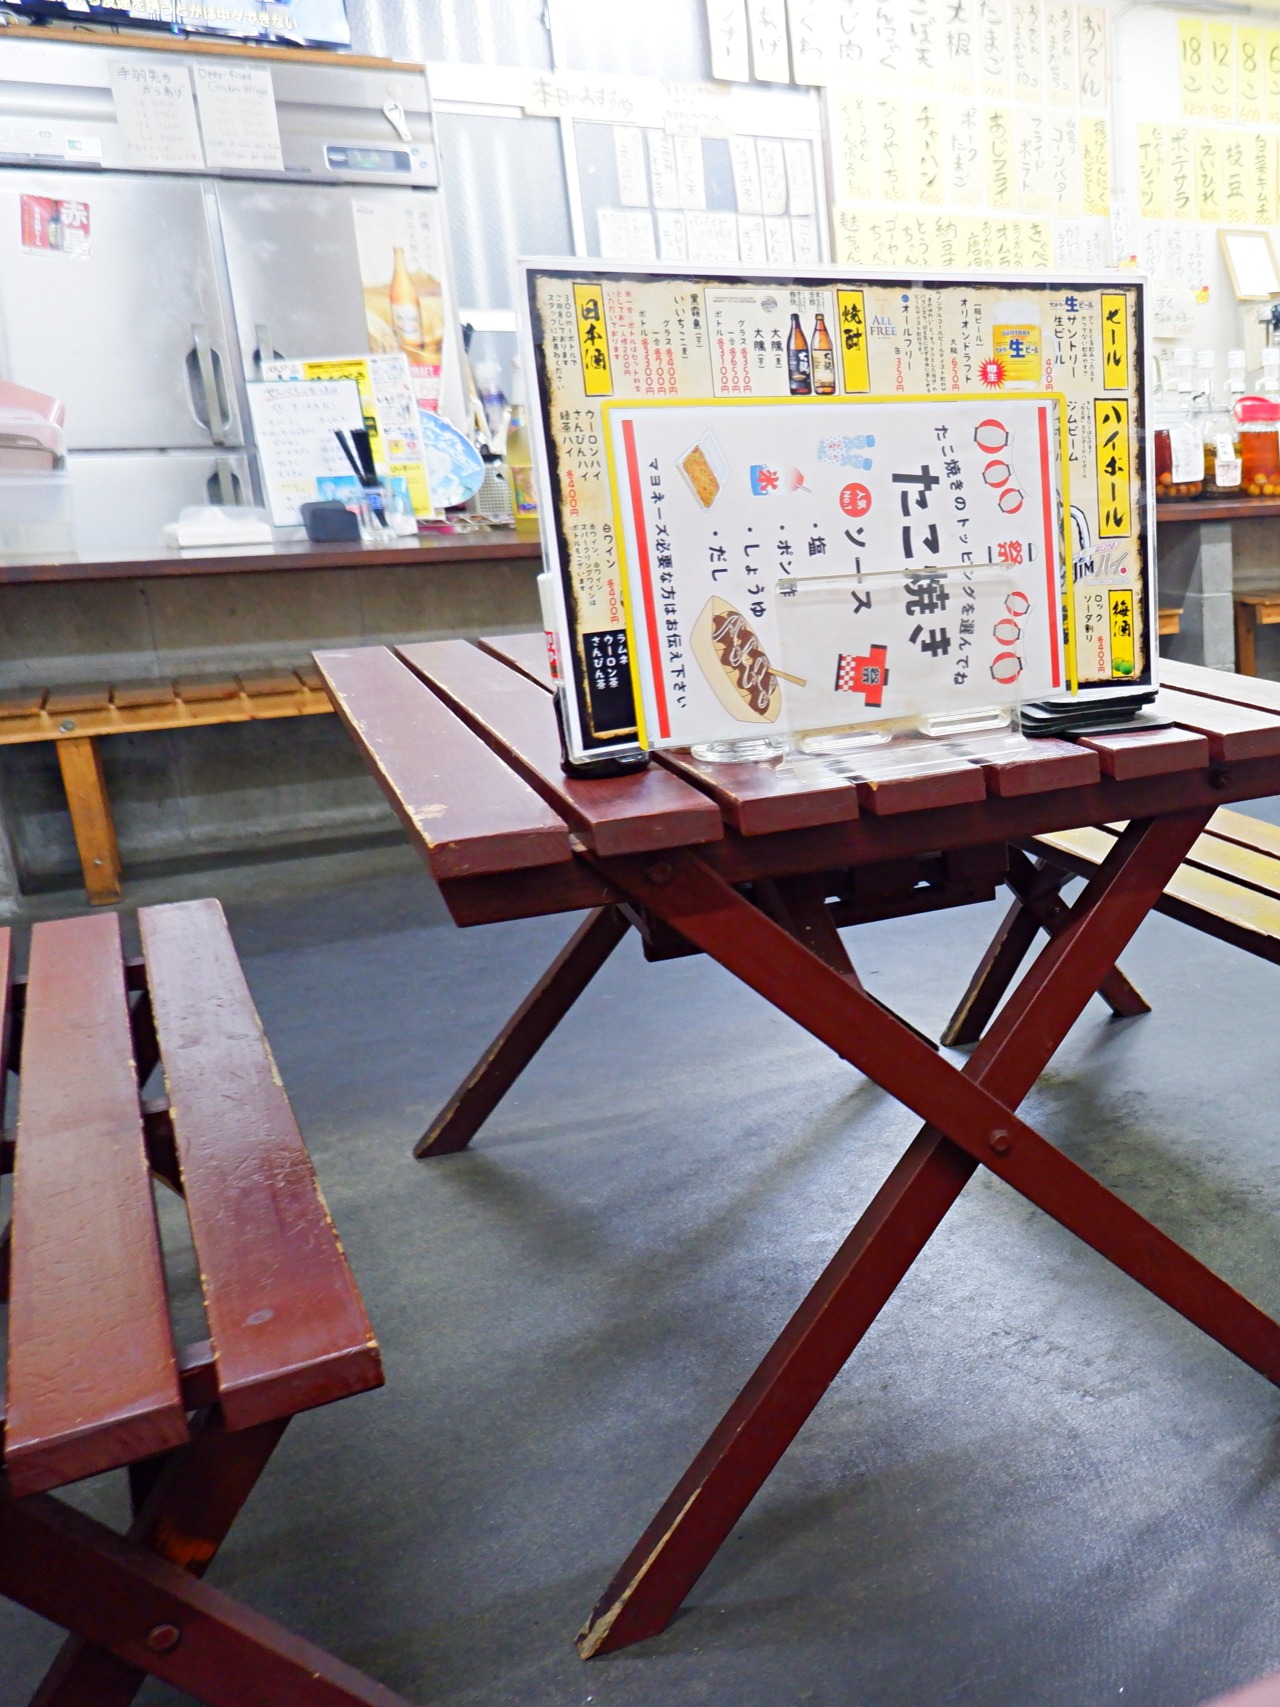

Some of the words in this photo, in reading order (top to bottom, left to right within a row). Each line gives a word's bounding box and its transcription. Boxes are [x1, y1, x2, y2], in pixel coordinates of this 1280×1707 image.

[839, 0, 863, 60] じ肉
[1081, 15, 1104, 97] おでん
[581, 298, 607, 371] 日本酒
[663, 319, 673, 345] グラス
[738, 319, 748, 346] グラス
[841, 303, 863, 351] 焼酎
[870, 326, 897, 336] FREE
[872, 315, 893, 326] ALL
[902, 304, 913, 371] オールフリー
[961, 298, 972, 384] オリオンドラフト
[1053, 315, 1066, 365] 生ビール
[1106, 308, 1122, 367] ビール
[1067, 315, 1078, 378] サントリー
[896, 357, 905, 392] 350円
[951, 357, 960, 392] 650円
[1045, 358, 1054, 391] 400円
[560, 410, 574, 458] 緑茶ハイ
[573, 409, 589, 481] さんぴんハイ
[585, 409, 601, 481] ウーロンハイ
[1067, 400, 1078, 462] ジムビーム
[757, 468, 779, 493] 氷
[1102, 405, 1125, 528] ハイボール
[566, 469, 579, 517] 各400円
[843, 489, 852, 511] No.1
[856, 489, 868, 511] 人気
[602, 522, 616, 569] 白ワイン
[709, 545, 728, 582] だし
[777, 539, 799, 598] ポン酢
[808, 536, 827, 557] 塩
[892, 464, 952, 658] たこ焼き
[934, 424, 976, 686] たこ焼きのトッピングを選んでね
[998, 540, 1023, 566] 祭
[648, 458, 687, 709] マヨネーズ必要な方はお伝え下さい
[744, 543, 767, 618] しょうゆ
[844, 526, 873, 614] ソース
[1072, 559, 1095, 585] JIM
[1084, 595, 1094, 643] ソーダ割り
[1095, 594, 1103, 623] ロック
[1112, 599, 1131, 638] 梅酒
[591, 635, 607, 690] さんぴん茶
[603, 635, 619, 689] ウーロン茶
[616, 634, 629, 665] ラムネ
[861, 666, 880, 686] 祭
